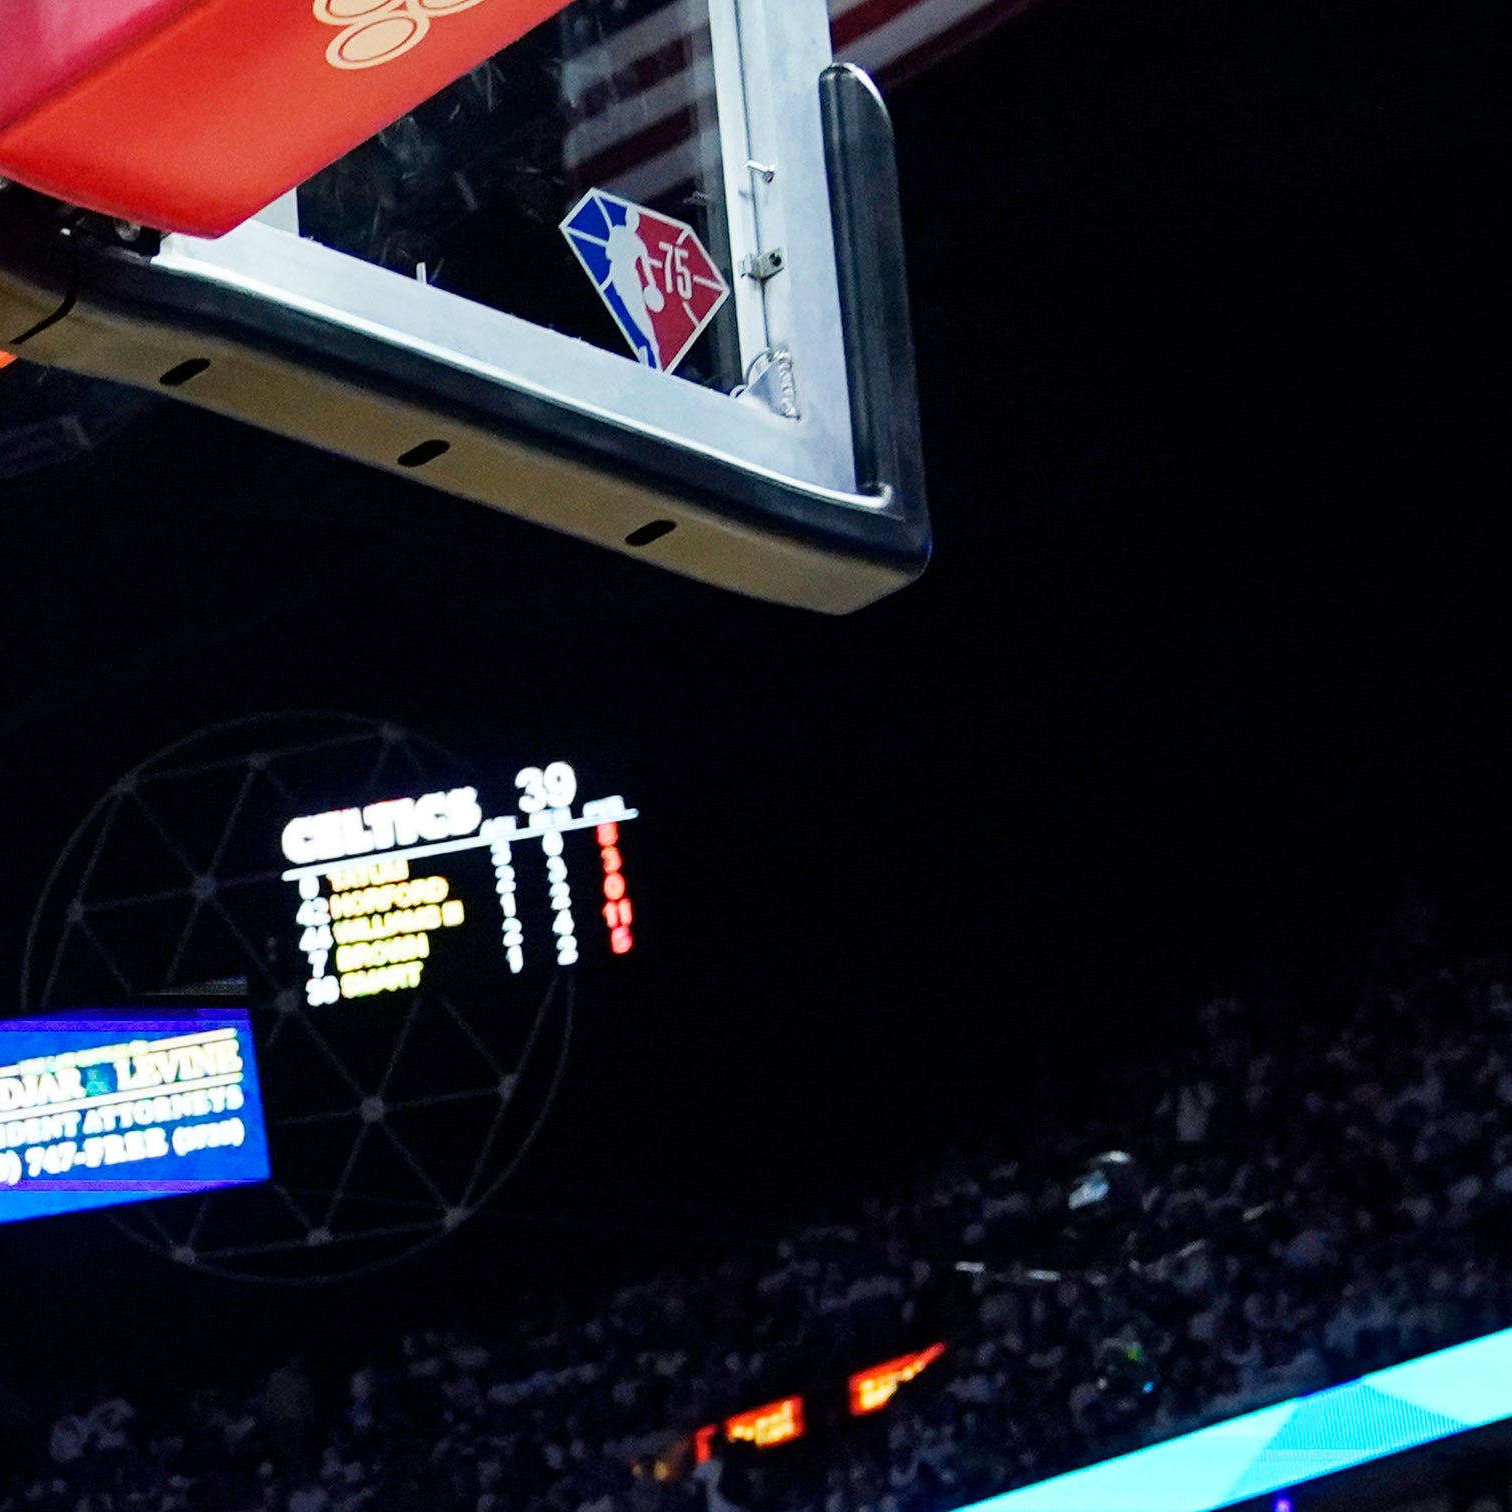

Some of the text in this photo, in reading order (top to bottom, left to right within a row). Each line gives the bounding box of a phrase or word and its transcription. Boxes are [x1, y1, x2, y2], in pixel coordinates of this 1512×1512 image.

[659, 241, 693, 300] 75
[281, 761, 577, 865] CELTICS 39
[81, 1084, 246, 1135] ATTORNEYS
